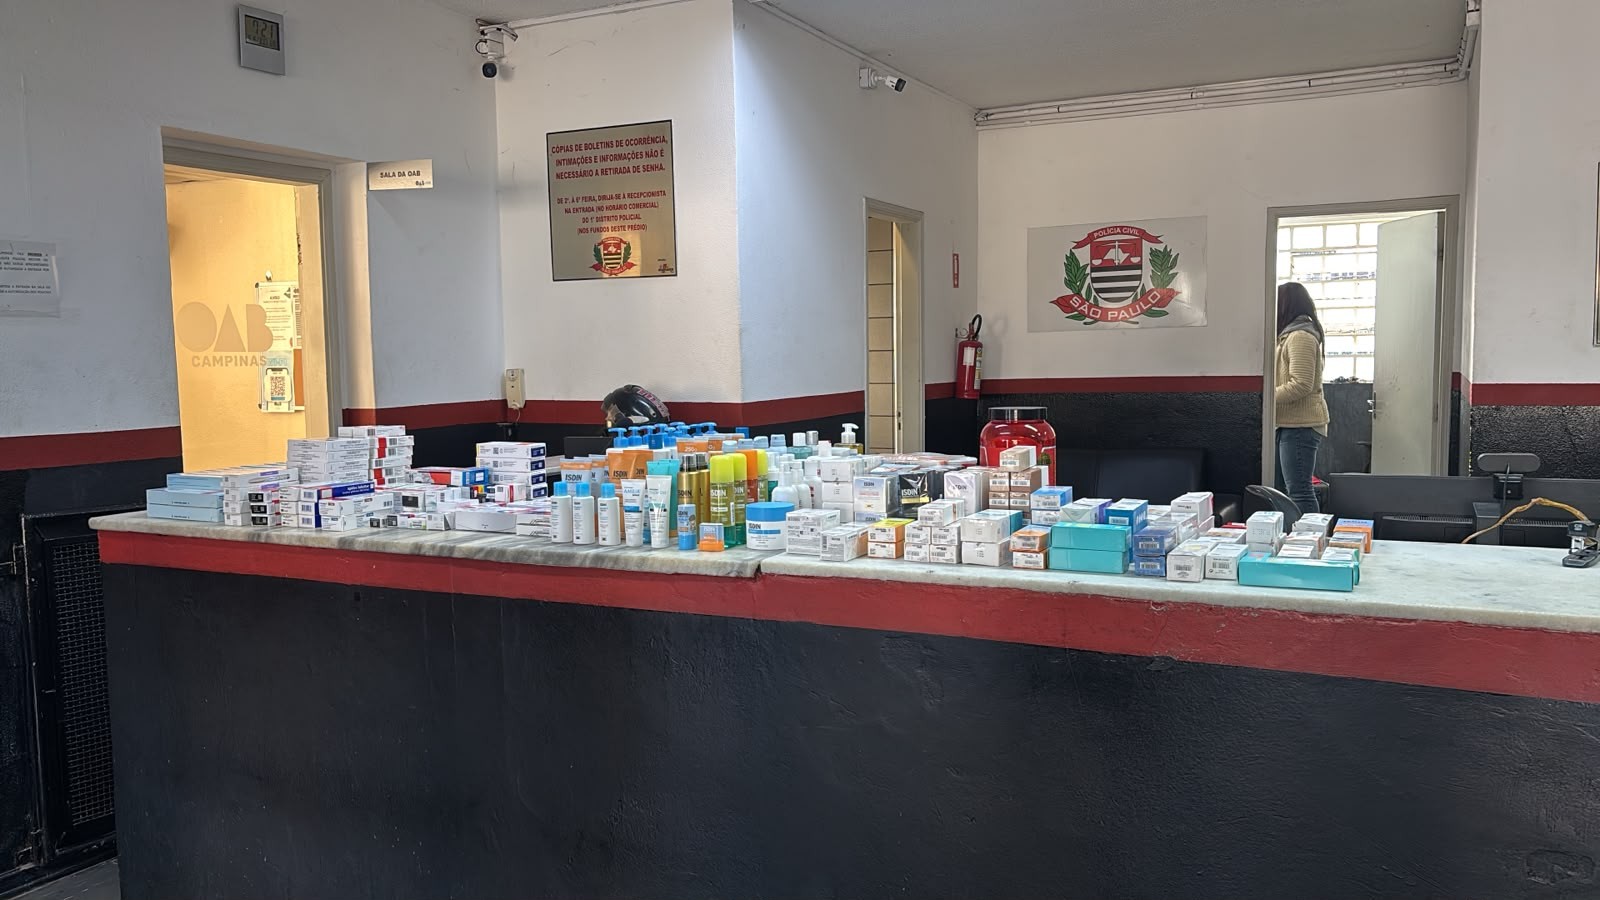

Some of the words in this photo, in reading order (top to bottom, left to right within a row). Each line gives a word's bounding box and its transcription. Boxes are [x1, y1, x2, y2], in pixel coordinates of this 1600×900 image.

[552, 145, 573, 153] CÓPIAS
[584, 141, 614, 150] BOLETINS
[625, 135, 668, 147] OCORRÊNCIA,
[556, 156, 592, 167] INTIMAÇÕES
[600, 152, 643, 162] INFORMAÇÕES
[645, 149, 658, 158] NÃO
[660, 148, 664, 157] É
[556, 168, 593, 180] NECESSÁRIO
[601, 166, 631, 176] RETIRADA
[642, 163, 665, 172] SENHA.
[598, 193, 621, 201] DIRIJA-SE
[627, 190, 666, 199] RECEPCIONISTA
[596, 205, 604, 213] (NO
[606, 203, 627, 211] HORÁRIO
[1094, 227, 1121, 239] POLÍCIA
[1123, 227, 1139, 235] CIVIL
[1070, 296, 1101, 318] SÃO
[1107, 291, 1160, 320] PAULO
[176, 302, 273, 352] OAB
[192, 355, 267, 367] CAMPINAS
[902, 488, 918, 496] ISDIN
